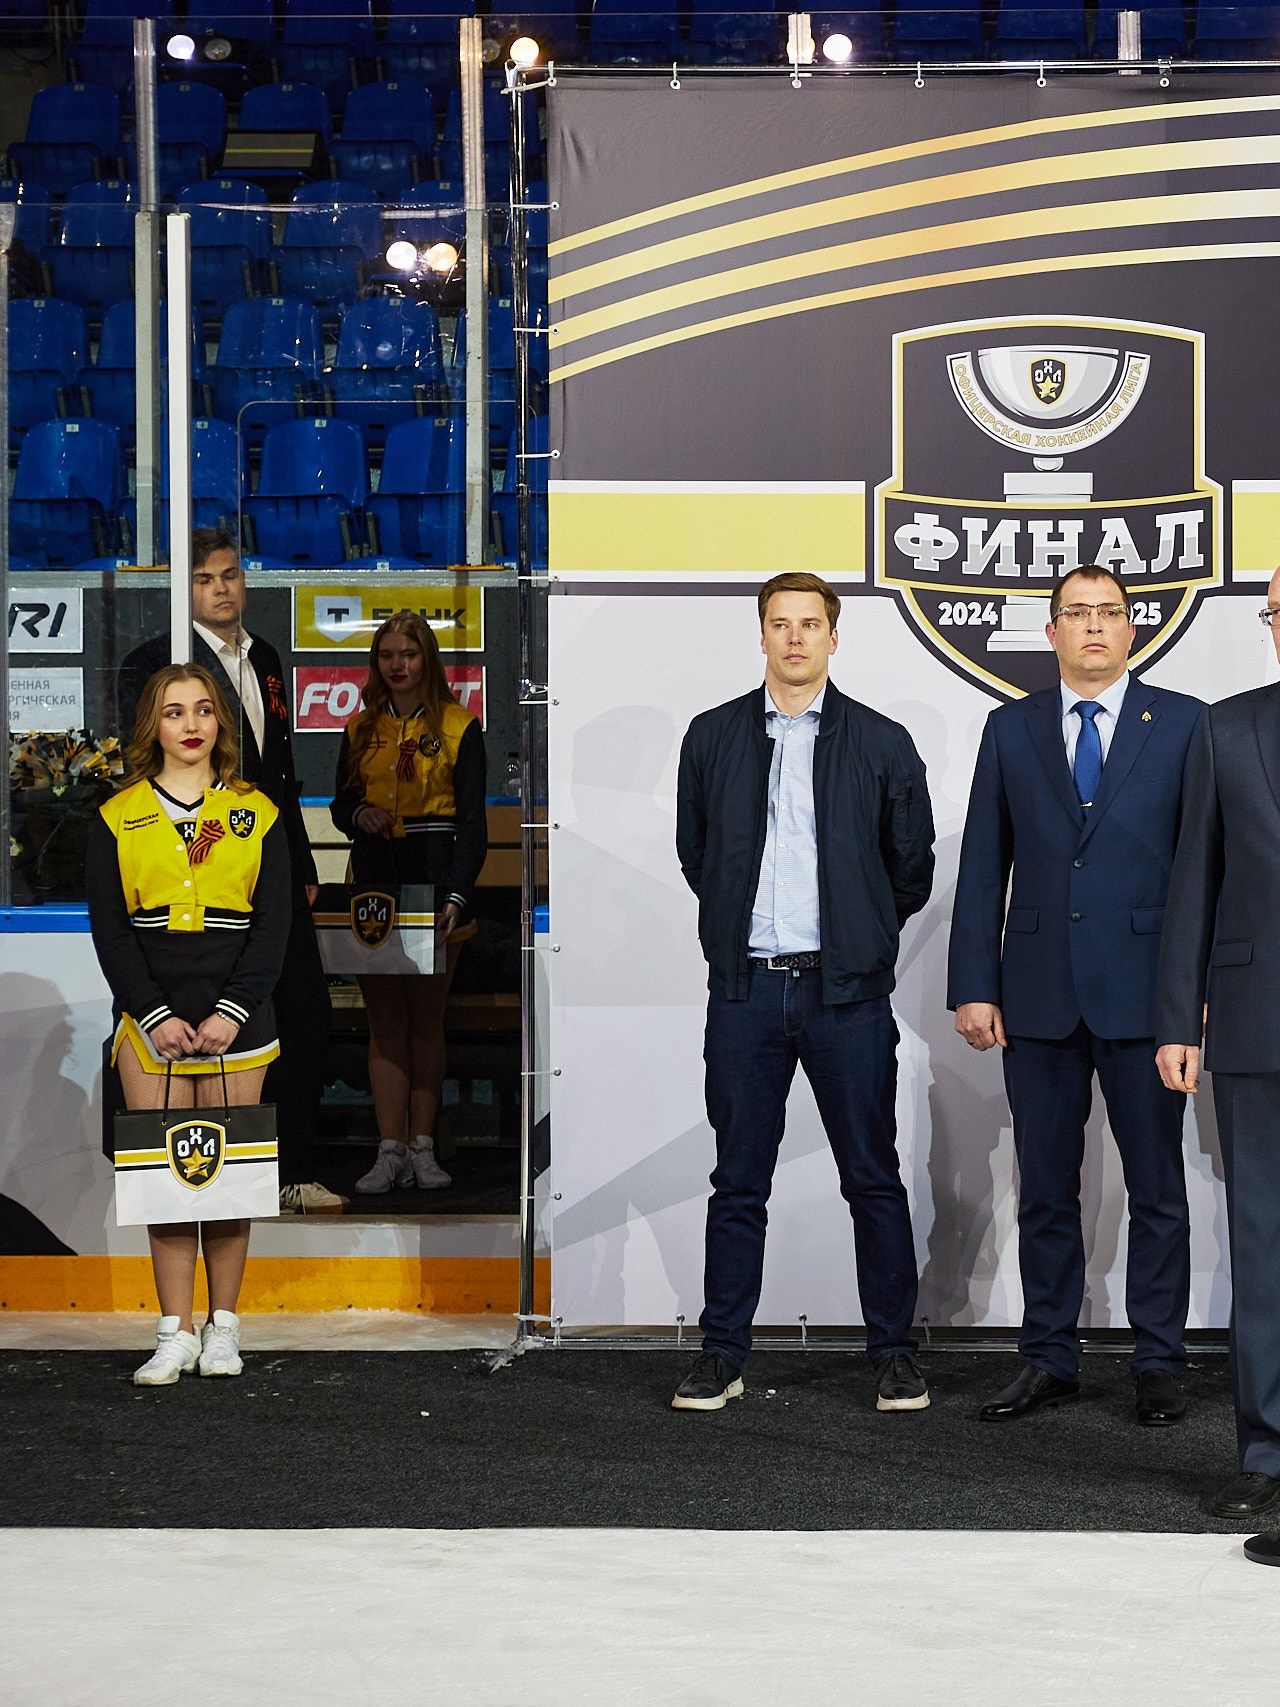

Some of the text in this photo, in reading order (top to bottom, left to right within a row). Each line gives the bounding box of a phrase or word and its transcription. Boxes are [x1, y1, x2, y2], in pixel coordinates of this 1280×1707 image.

[1034, 360, 1062, 382] ОХЛ
[955, 362, 1143, 447] ОФИЦЕРСКАЯ ХОККЕЙНАЯ ЛИГА
[893, 509, 1205, 577] ФИНАЛ
[937, 601, 1162, 626] 2024 25
[8, 680, 50, 690] ЕННАЯ
[299, 681, 481, 717] FOT
[177, 1127, 216, 1157] ОХЛ
